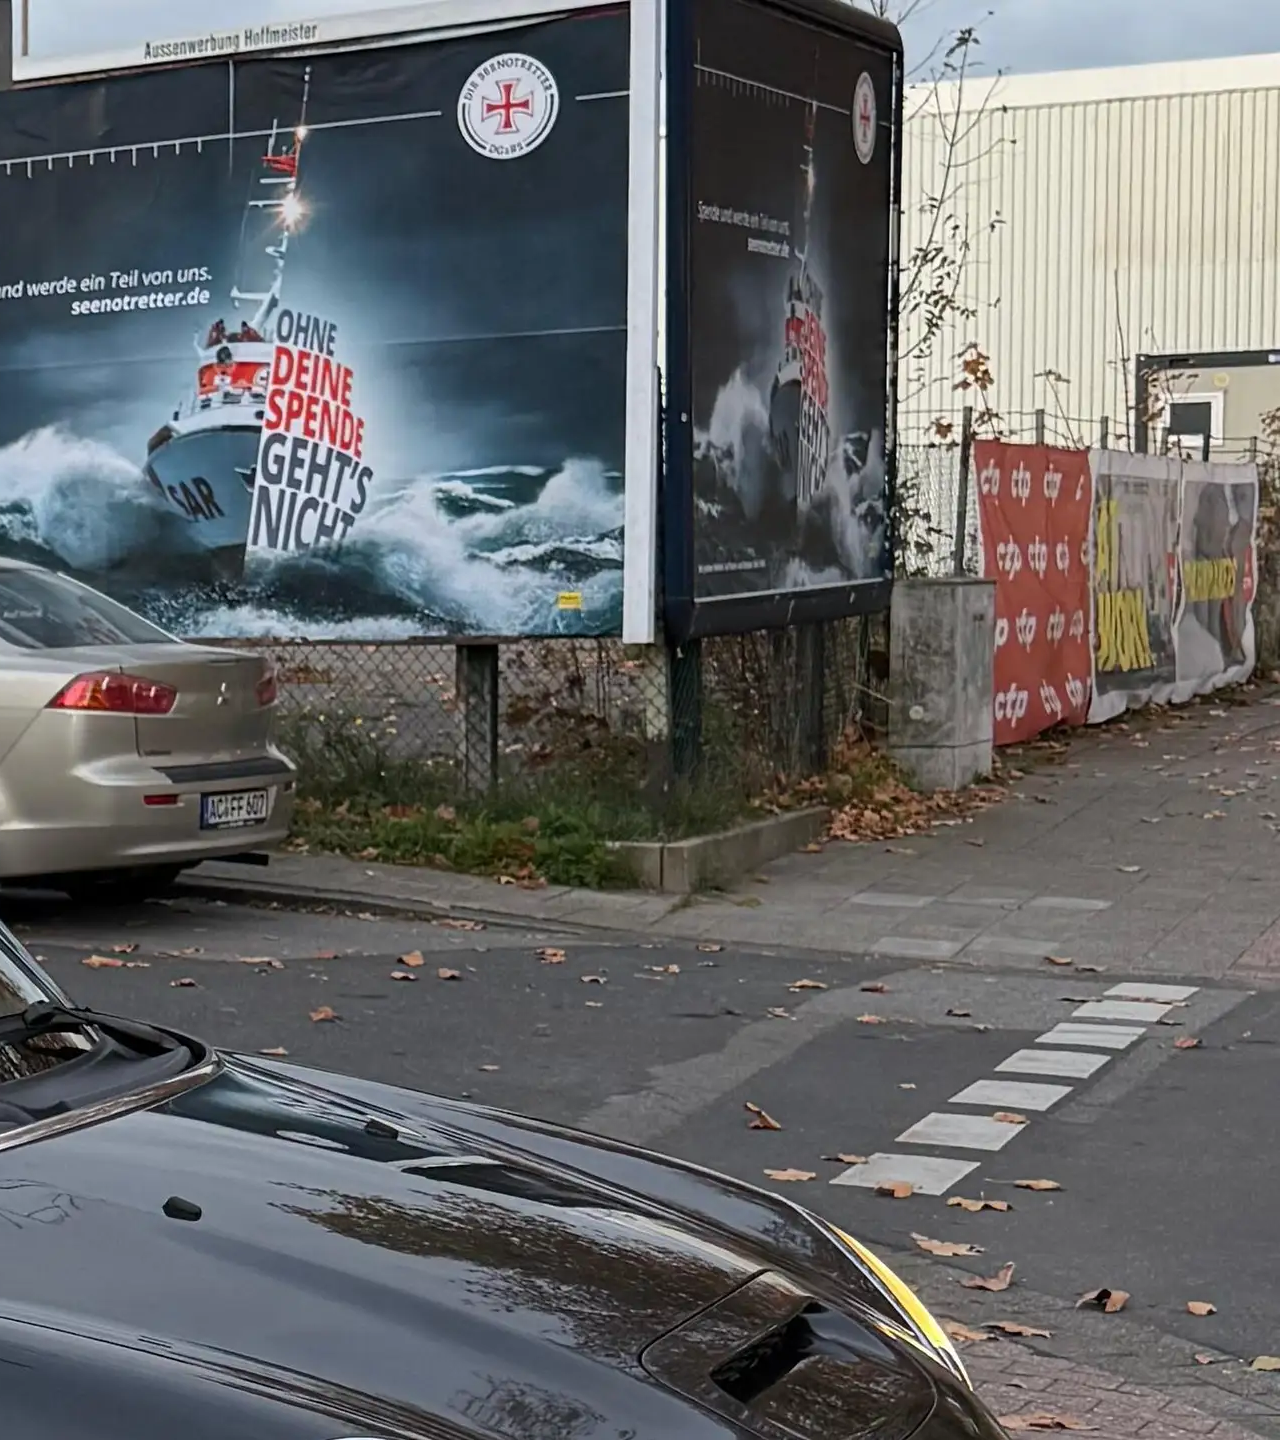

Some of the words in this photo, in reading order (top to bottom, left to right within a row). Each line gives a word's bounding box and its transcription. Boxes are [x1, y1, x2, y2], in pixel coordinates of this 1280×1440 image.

[144, 34, 240, 59] Aussenwerbung
[27, 276, 77, 297] werde
[80, 275, 105, 293] ein
[110, 270, 139, 289] Teil
[142, 269, 173, 286] von
[178, 266, 213, 283] uns.
[70, 286, 211, 316] seenotretter.de
[275, 308, 338, 357] OHNE
[271, 345, 354, 409] DEINE
[264, 387, 365, 460] SPENDE
[260, 432, 374, 515] GEHT'S
[251, 484, 356, 551] NICHT
[994, 682, 1029, 729] ctp
[210, 796, 225, 819] AC
